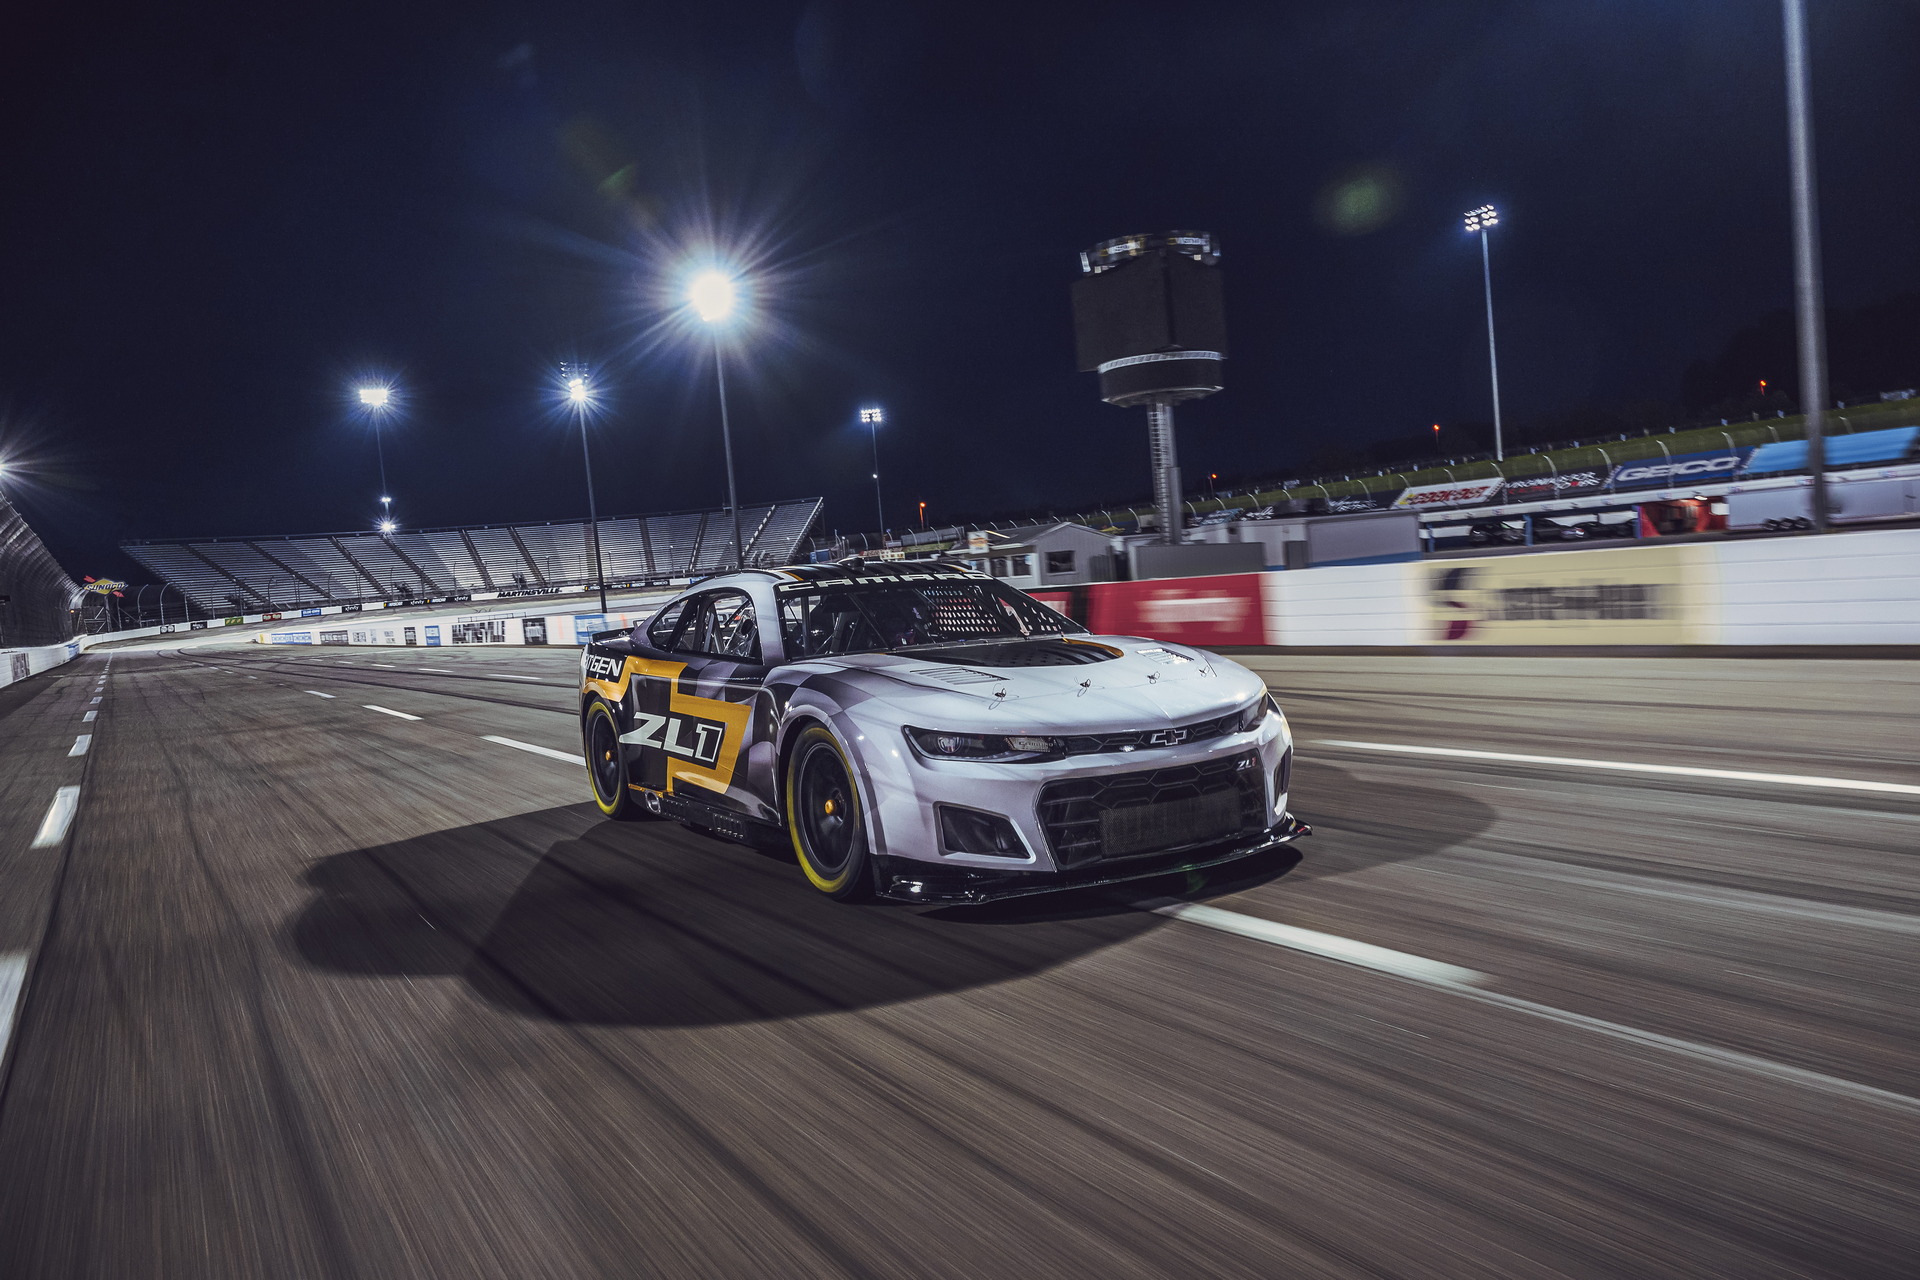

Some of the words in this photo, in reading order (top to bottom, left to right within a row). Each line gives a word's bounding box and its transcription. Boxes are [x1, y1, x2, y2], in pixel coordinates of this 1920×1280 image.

[1616, 457, 1741, 481] GEICO
[85, 582, 125, 591] SUNOCO
[778, 572, 994, 592] CAMARO
[497, 587, 560, 598] MARTINSVILLE
[619, 712, 723, 762] ZL1
[1237, 757, 1257, 771] ZL1
